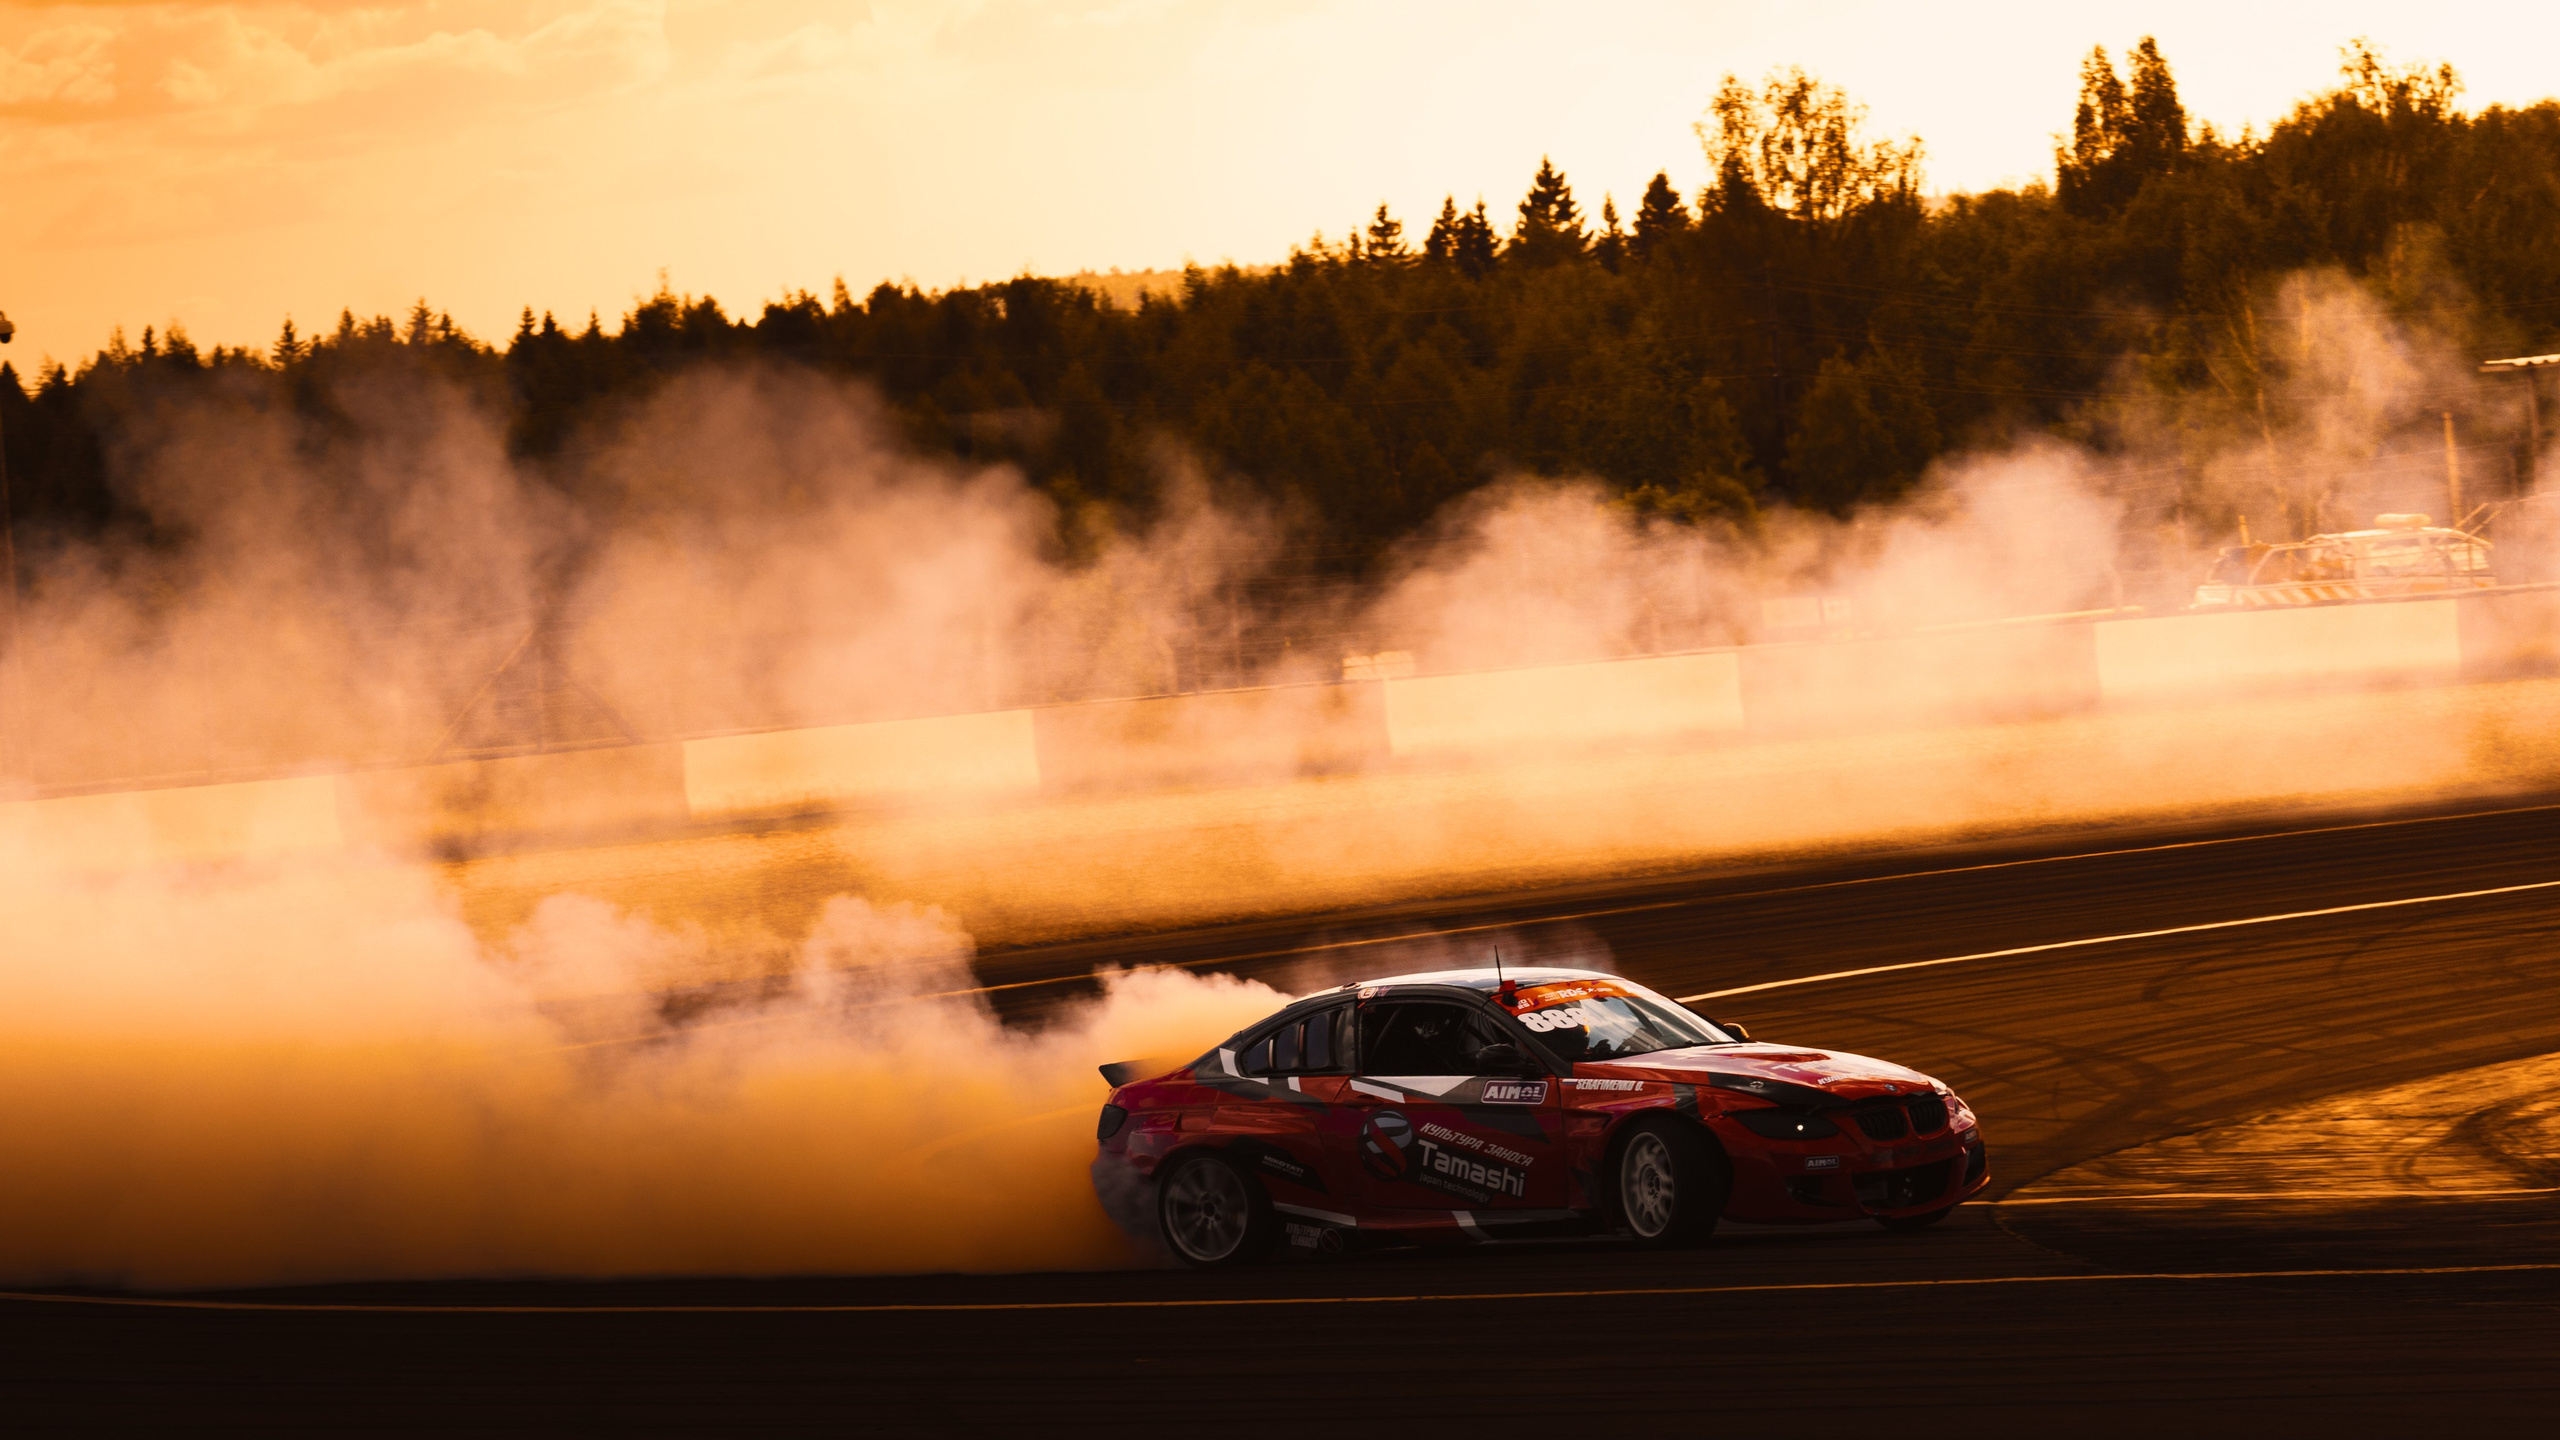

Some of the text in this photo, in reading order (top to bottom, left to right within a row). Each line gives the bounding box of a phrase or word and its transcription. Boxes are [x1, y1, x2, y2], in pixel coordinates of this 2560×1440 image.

[1557, 987, 1588, 999] RDS
[1484, 1085, 1542, 1100] AIMOL
[1576, 1079, 1636, 1092] SERAFIMENKO
[1419, 1122, 1535, 1167] КУЛЬТУРА ЗАНОСА
[1418, 1139, 1525, 1198] Tamashi
[1807, 1158, 1837, 1168] AIMOL
[1443, 1180, 1490, 1205] technology
